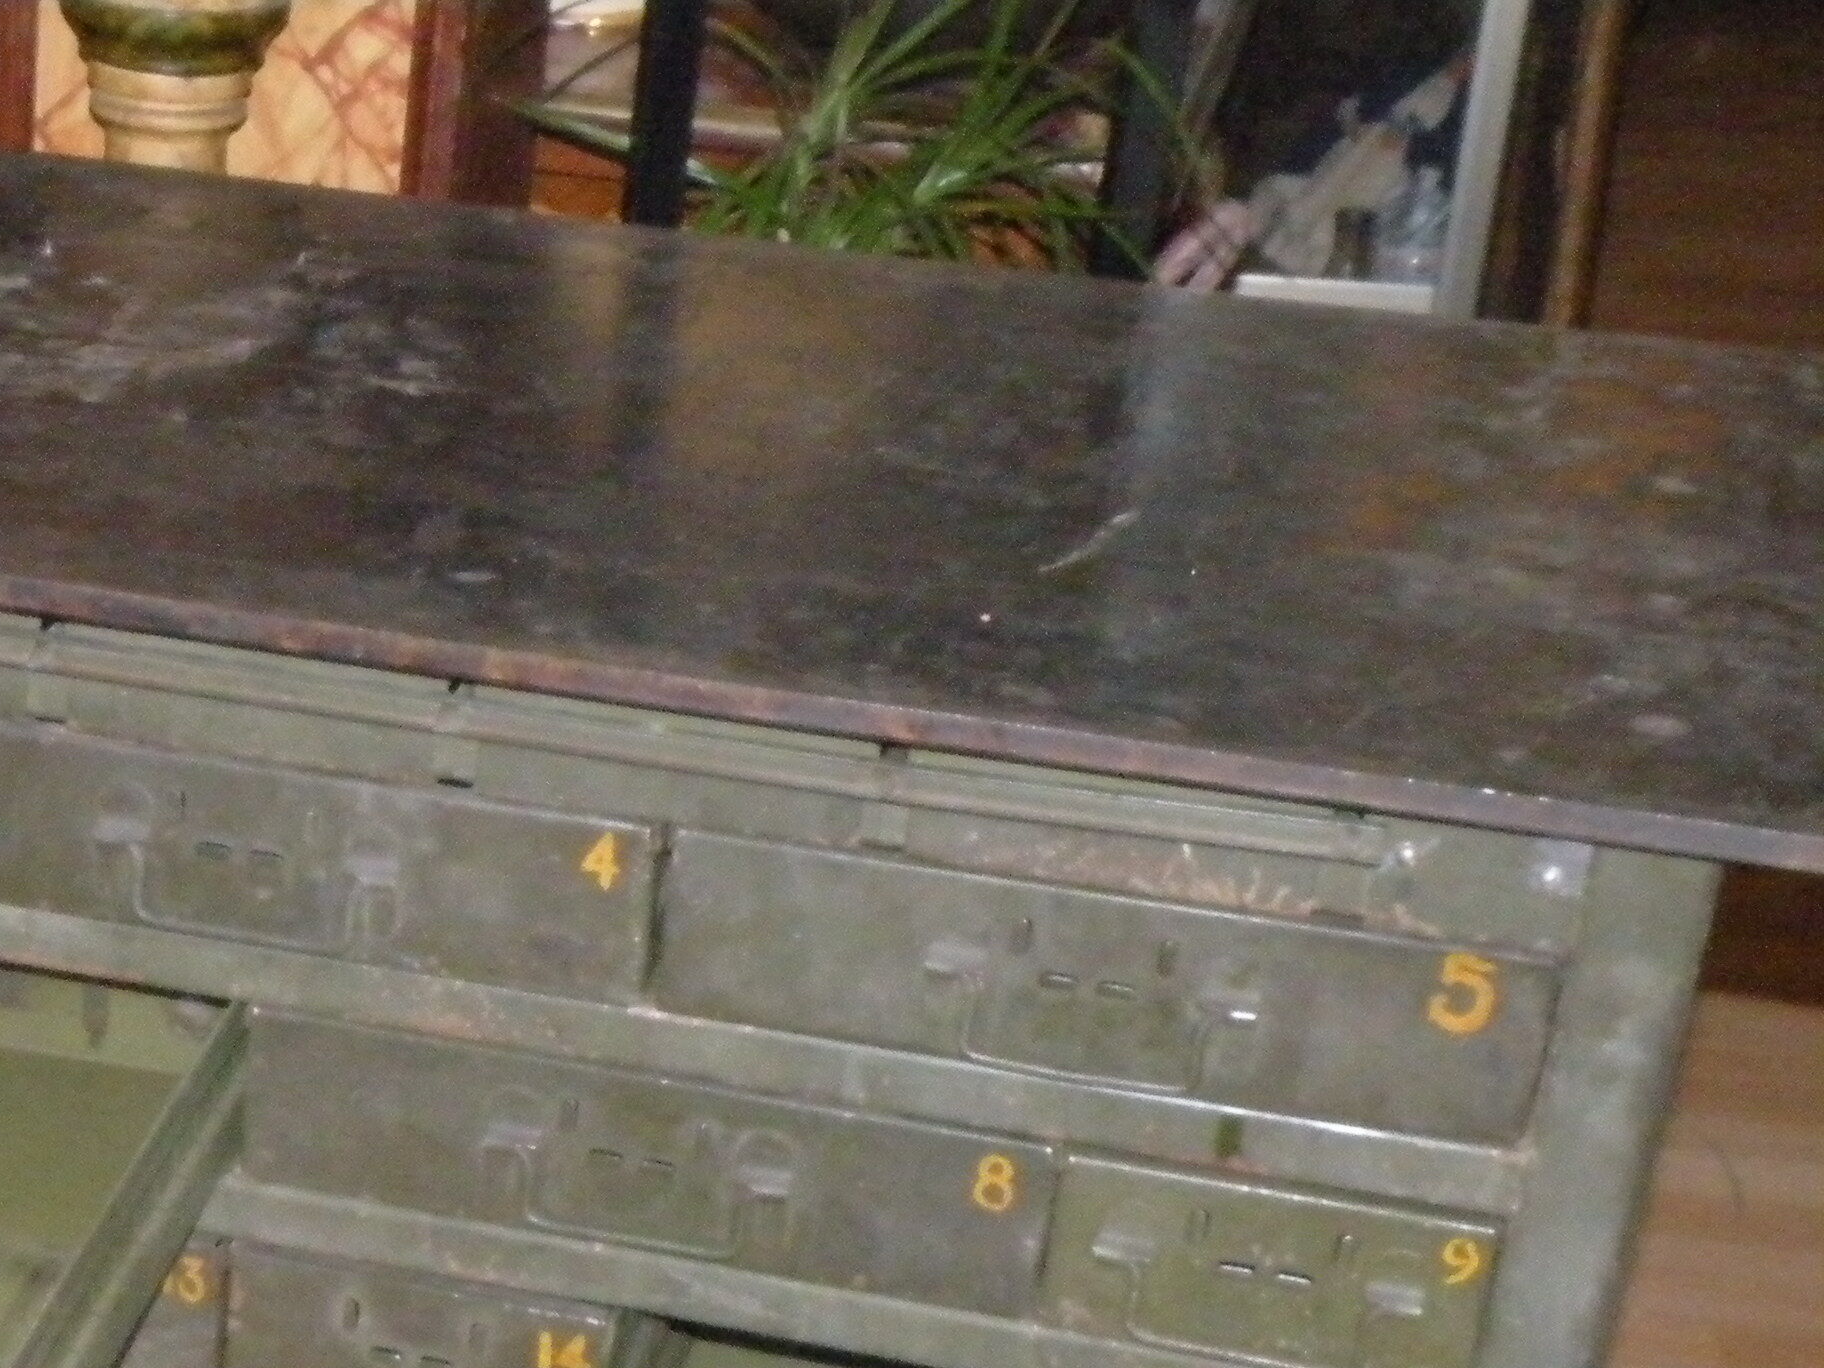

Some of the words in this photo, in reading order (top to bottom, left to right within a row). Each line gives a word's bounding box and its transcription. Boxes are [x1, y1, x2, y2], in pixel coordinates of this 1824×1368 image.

[580, 833, 619, 891] 4
[1426, 953, 1500, 1034] 5
[971, 1155, 1017, 1213] 8
[1440, 1239, 1488, 1284] 9
